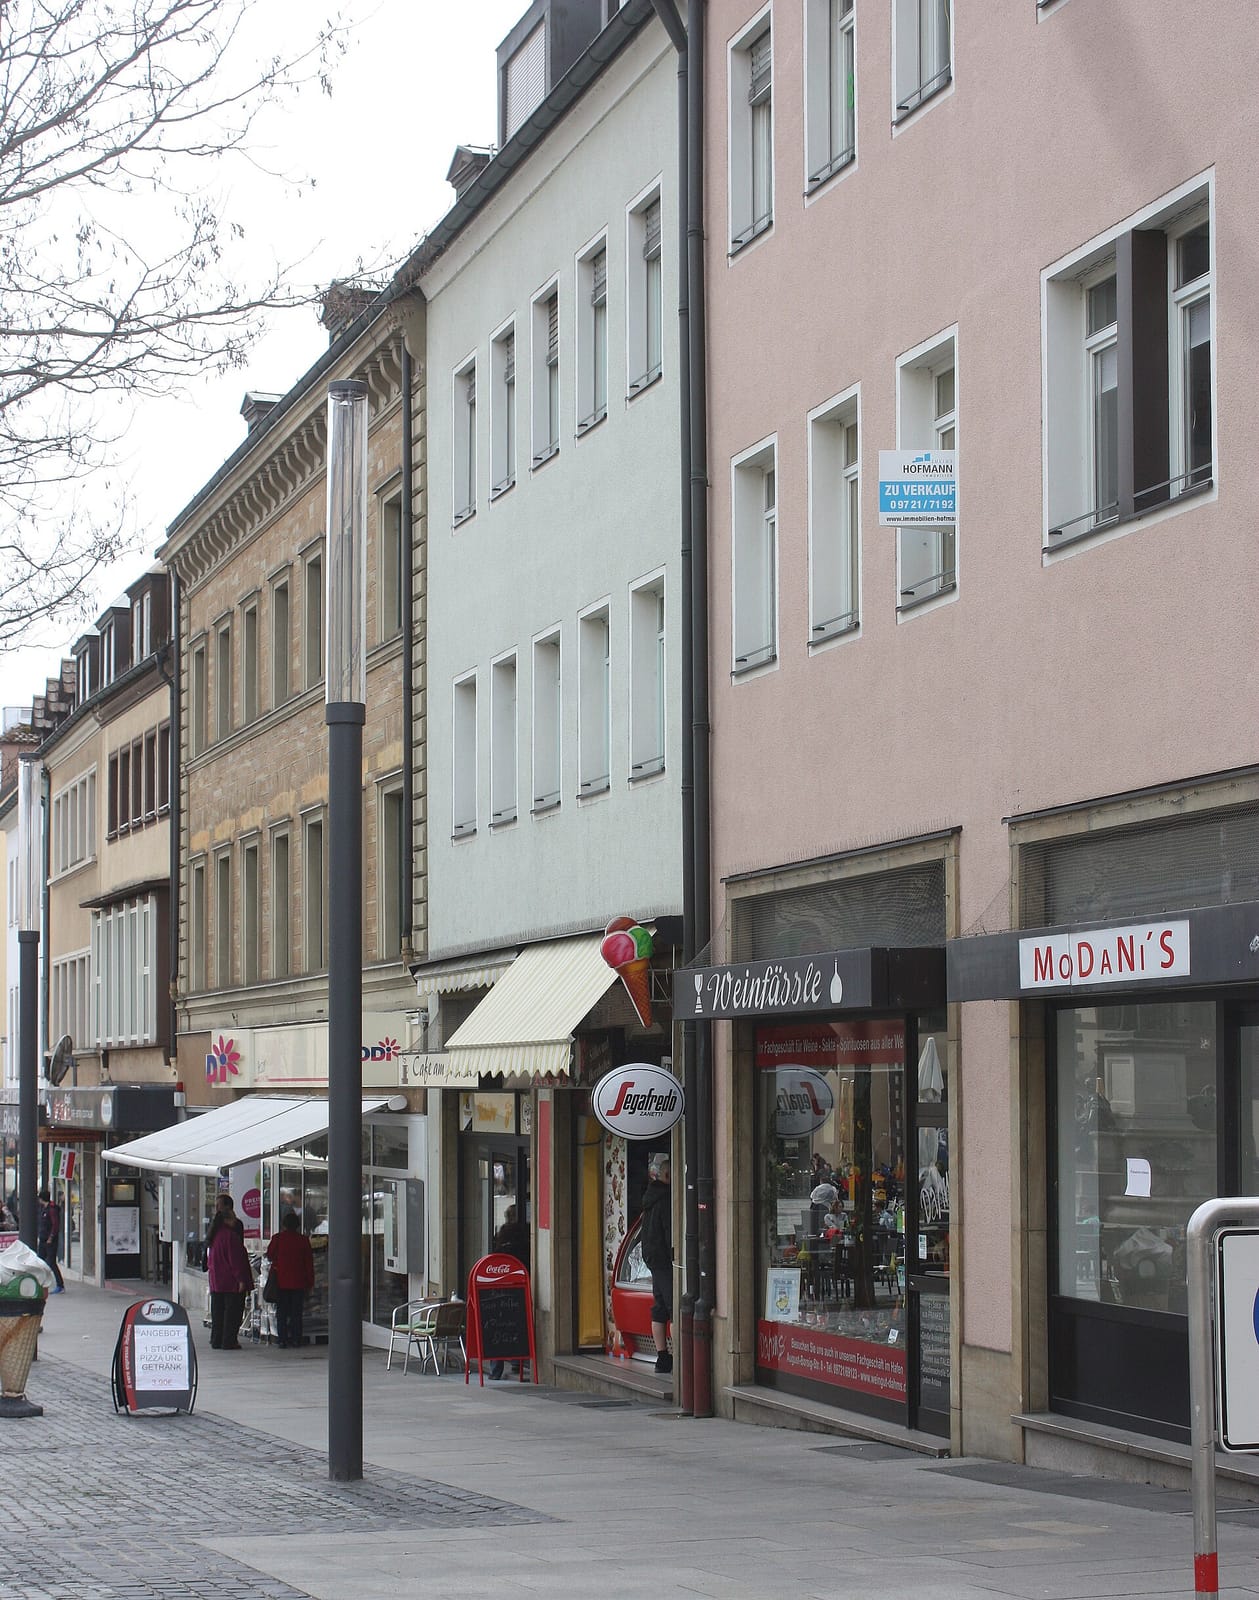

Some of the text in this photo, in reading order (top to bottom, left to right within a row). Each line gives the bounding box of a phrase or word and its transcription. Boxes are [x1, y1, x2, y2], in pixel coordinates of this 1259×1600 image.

[903, 464, 953, 474] HOFMANN
[885, 484, 956, 496] ZU VERKAUF
[707, 961, 823, 1011] Weinfässle
[870, 1038, 880, 1051] aus
[605, 1081, 678, 1117] Segafredo
[145, 1303, 170, 1316] Segafredo
[140, 1329, 181, 1337] ANGEBOT
[140, 1354, 183, 1362] PIZZA UND
[141, 1362, 182, 1371] GETRÄNK
[890, 1361, 904, 1375] Hafen
